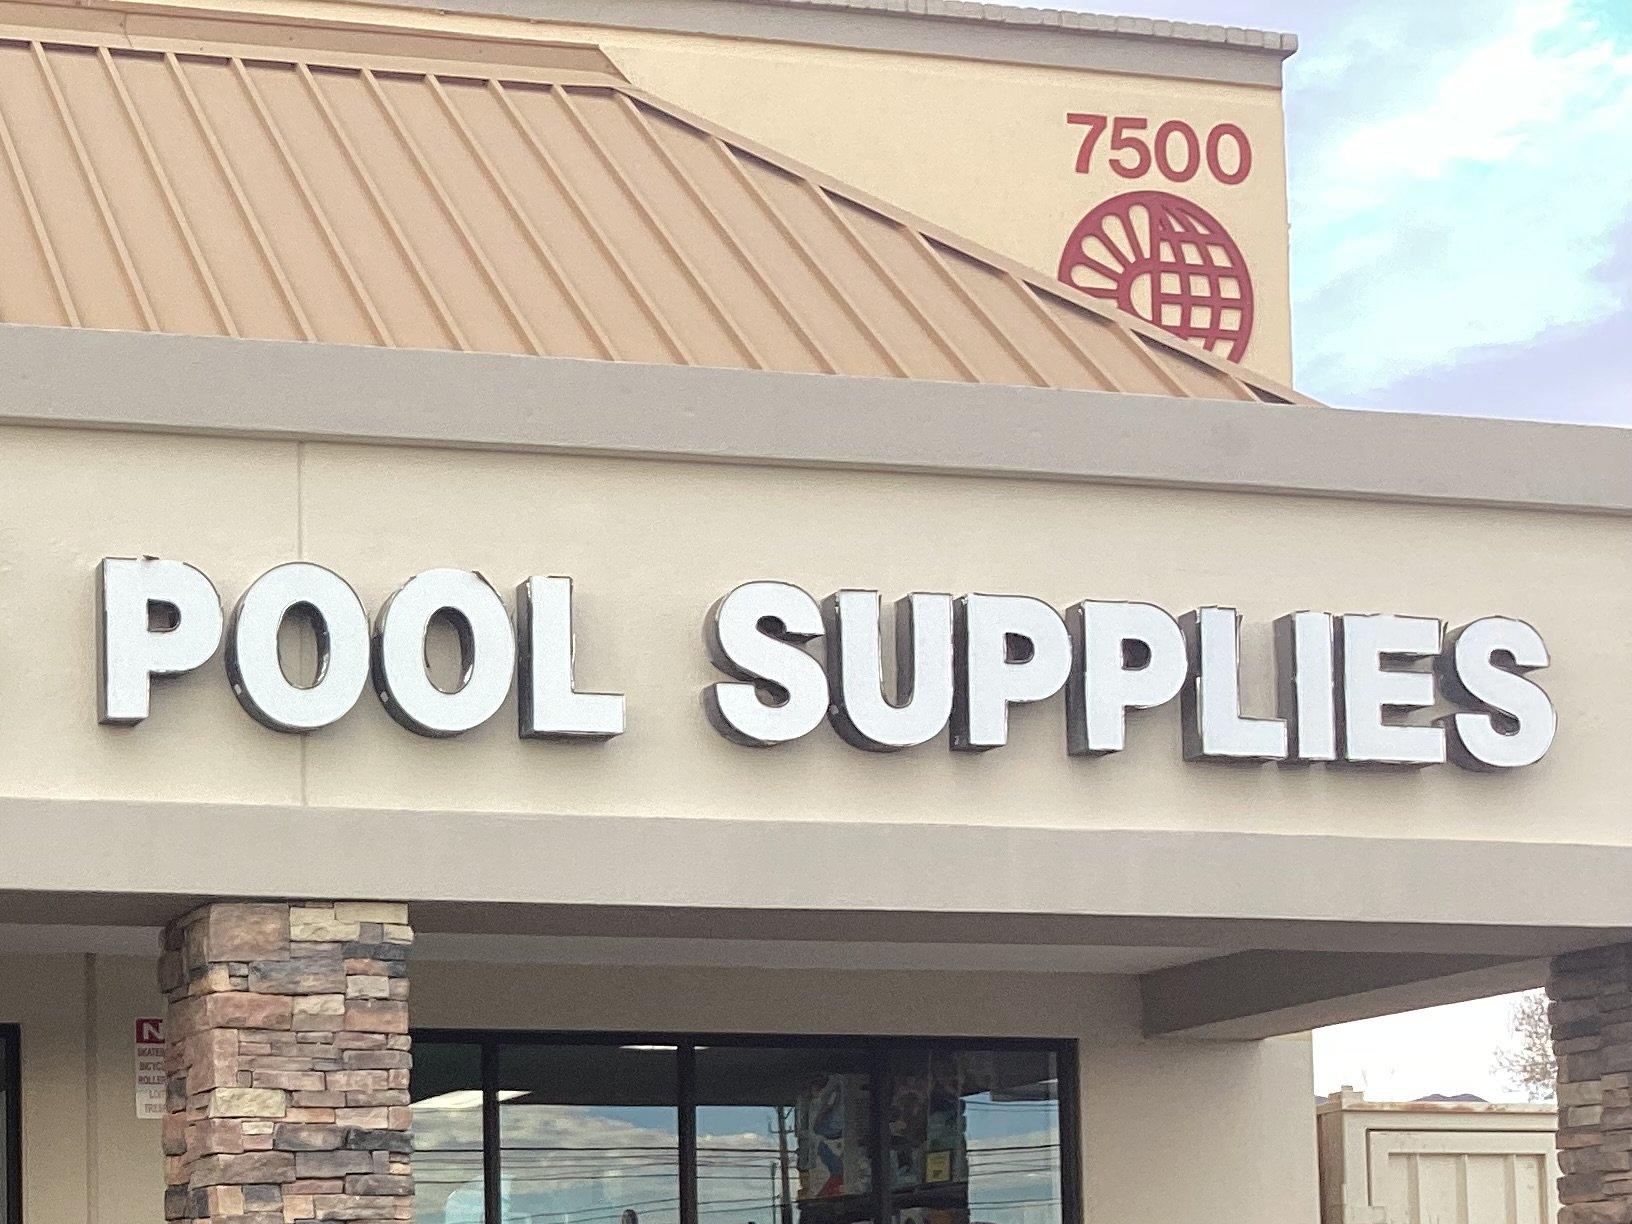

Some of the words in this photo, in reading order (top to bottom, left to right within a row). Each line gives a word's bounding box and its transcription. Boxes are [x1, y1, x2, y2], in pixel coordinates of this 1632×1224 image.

[1067, 113, 1252, 185] 7500
[96, 556, 625, 739] POOL
[704, 580, 1557, 771] SUPPLIES
[143, 1021, 166, 1041] N
